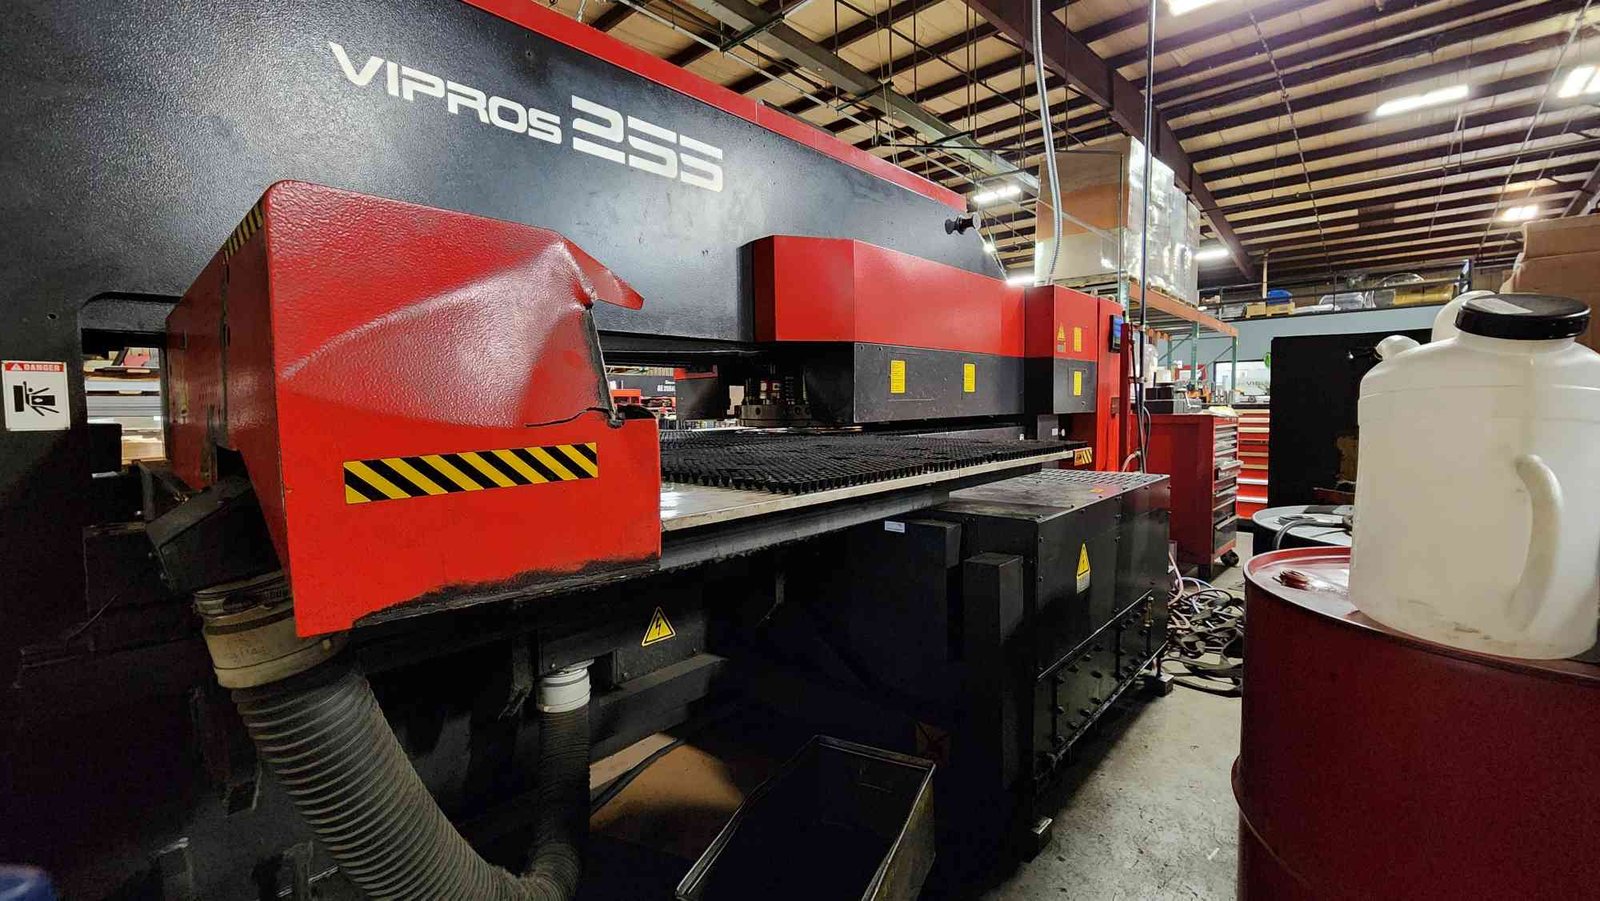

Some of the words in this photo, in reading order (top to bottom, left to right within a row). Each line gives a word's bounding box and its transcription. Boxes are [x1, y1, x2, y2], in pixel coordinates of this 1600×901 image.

[329, 42, 562, 144] VIPROS
[572, 95, 723, 193] 255
[24, 363, 61, 371] DANGER
